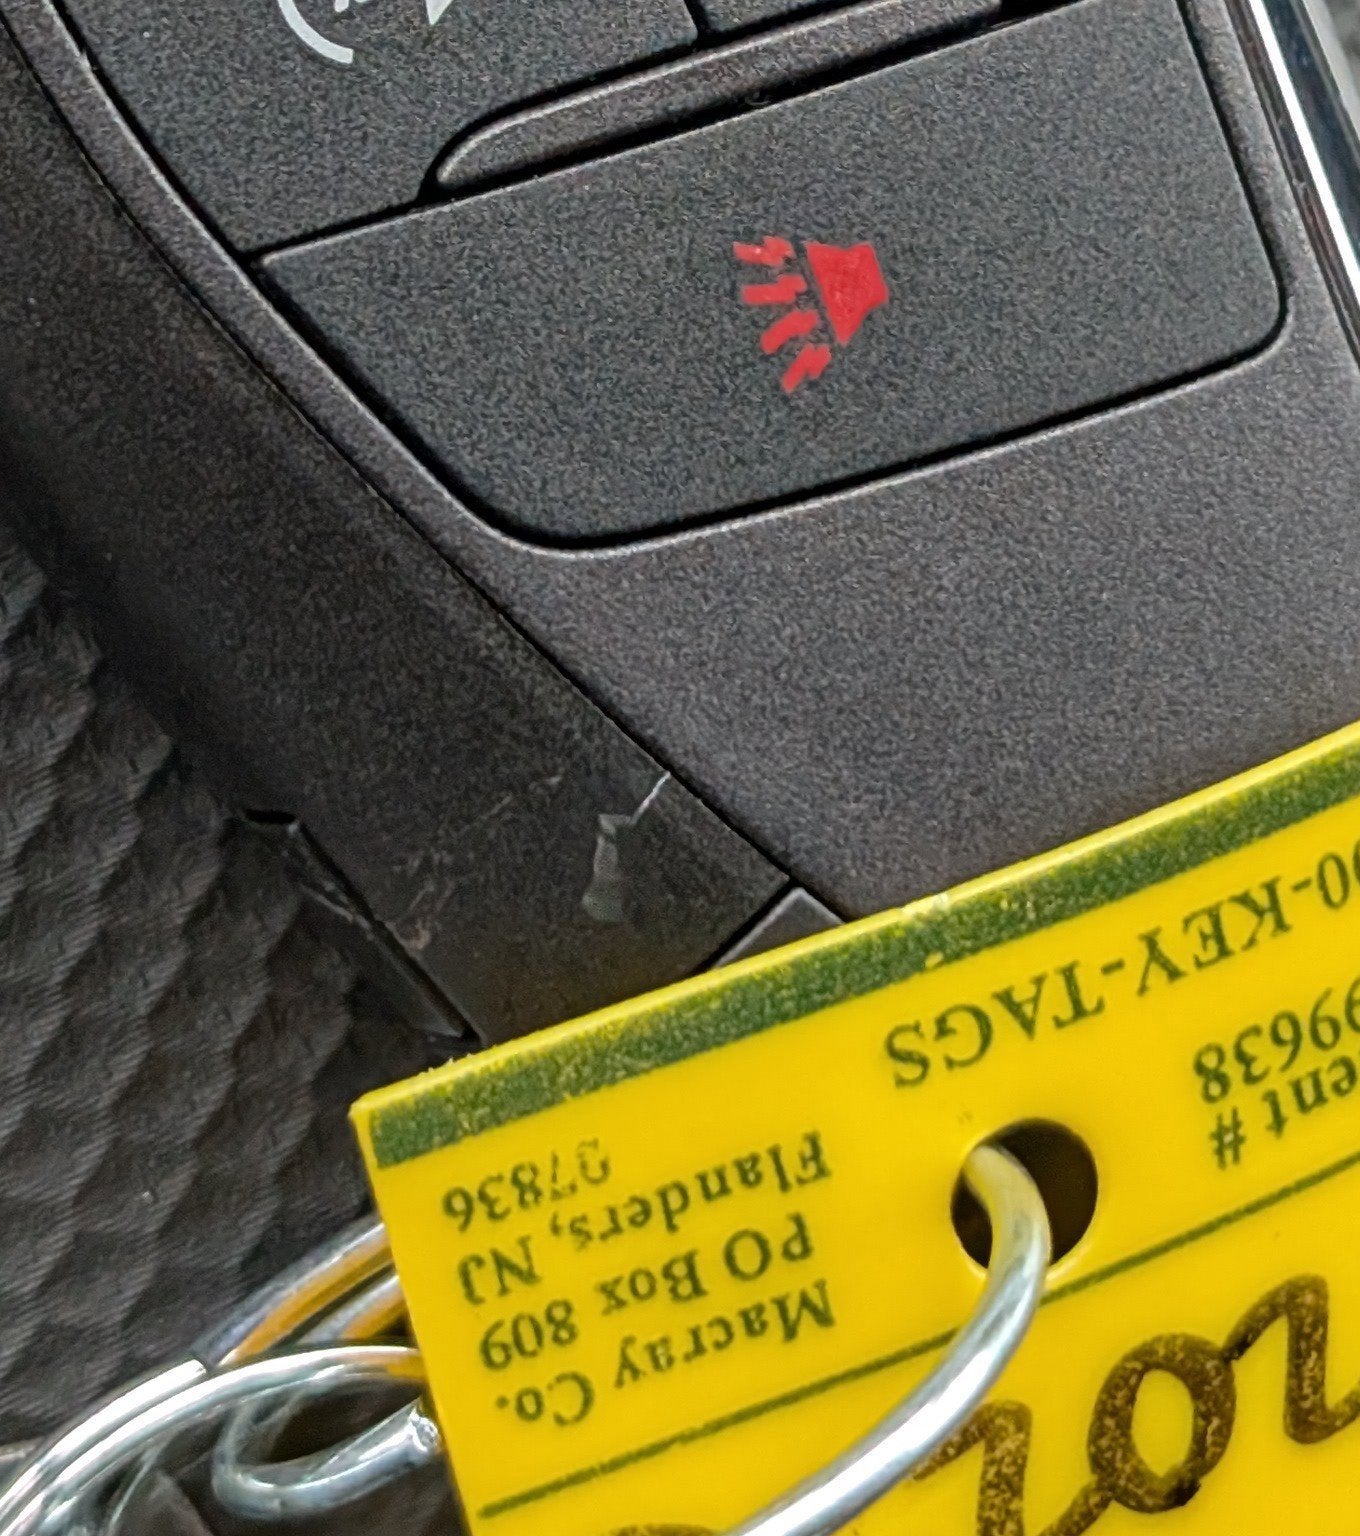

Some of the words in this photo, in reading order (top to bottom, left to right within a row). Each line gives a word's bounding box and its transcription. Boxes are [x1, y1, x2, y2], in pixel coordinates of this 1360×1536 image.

[1209, 1107, 1246, 1170] #
[551, 1131, 831, 1251] Flanders,
[458, 1235, 540, 1306] NJ
[598, 1248, 707, 1316] Box
[722, 1212, 814, 1282] PO
[480, 1299, 579, 1370] 809
[614, 1278, 835, 1389] Macray
[495, 1371, 596, 1427] Co.
